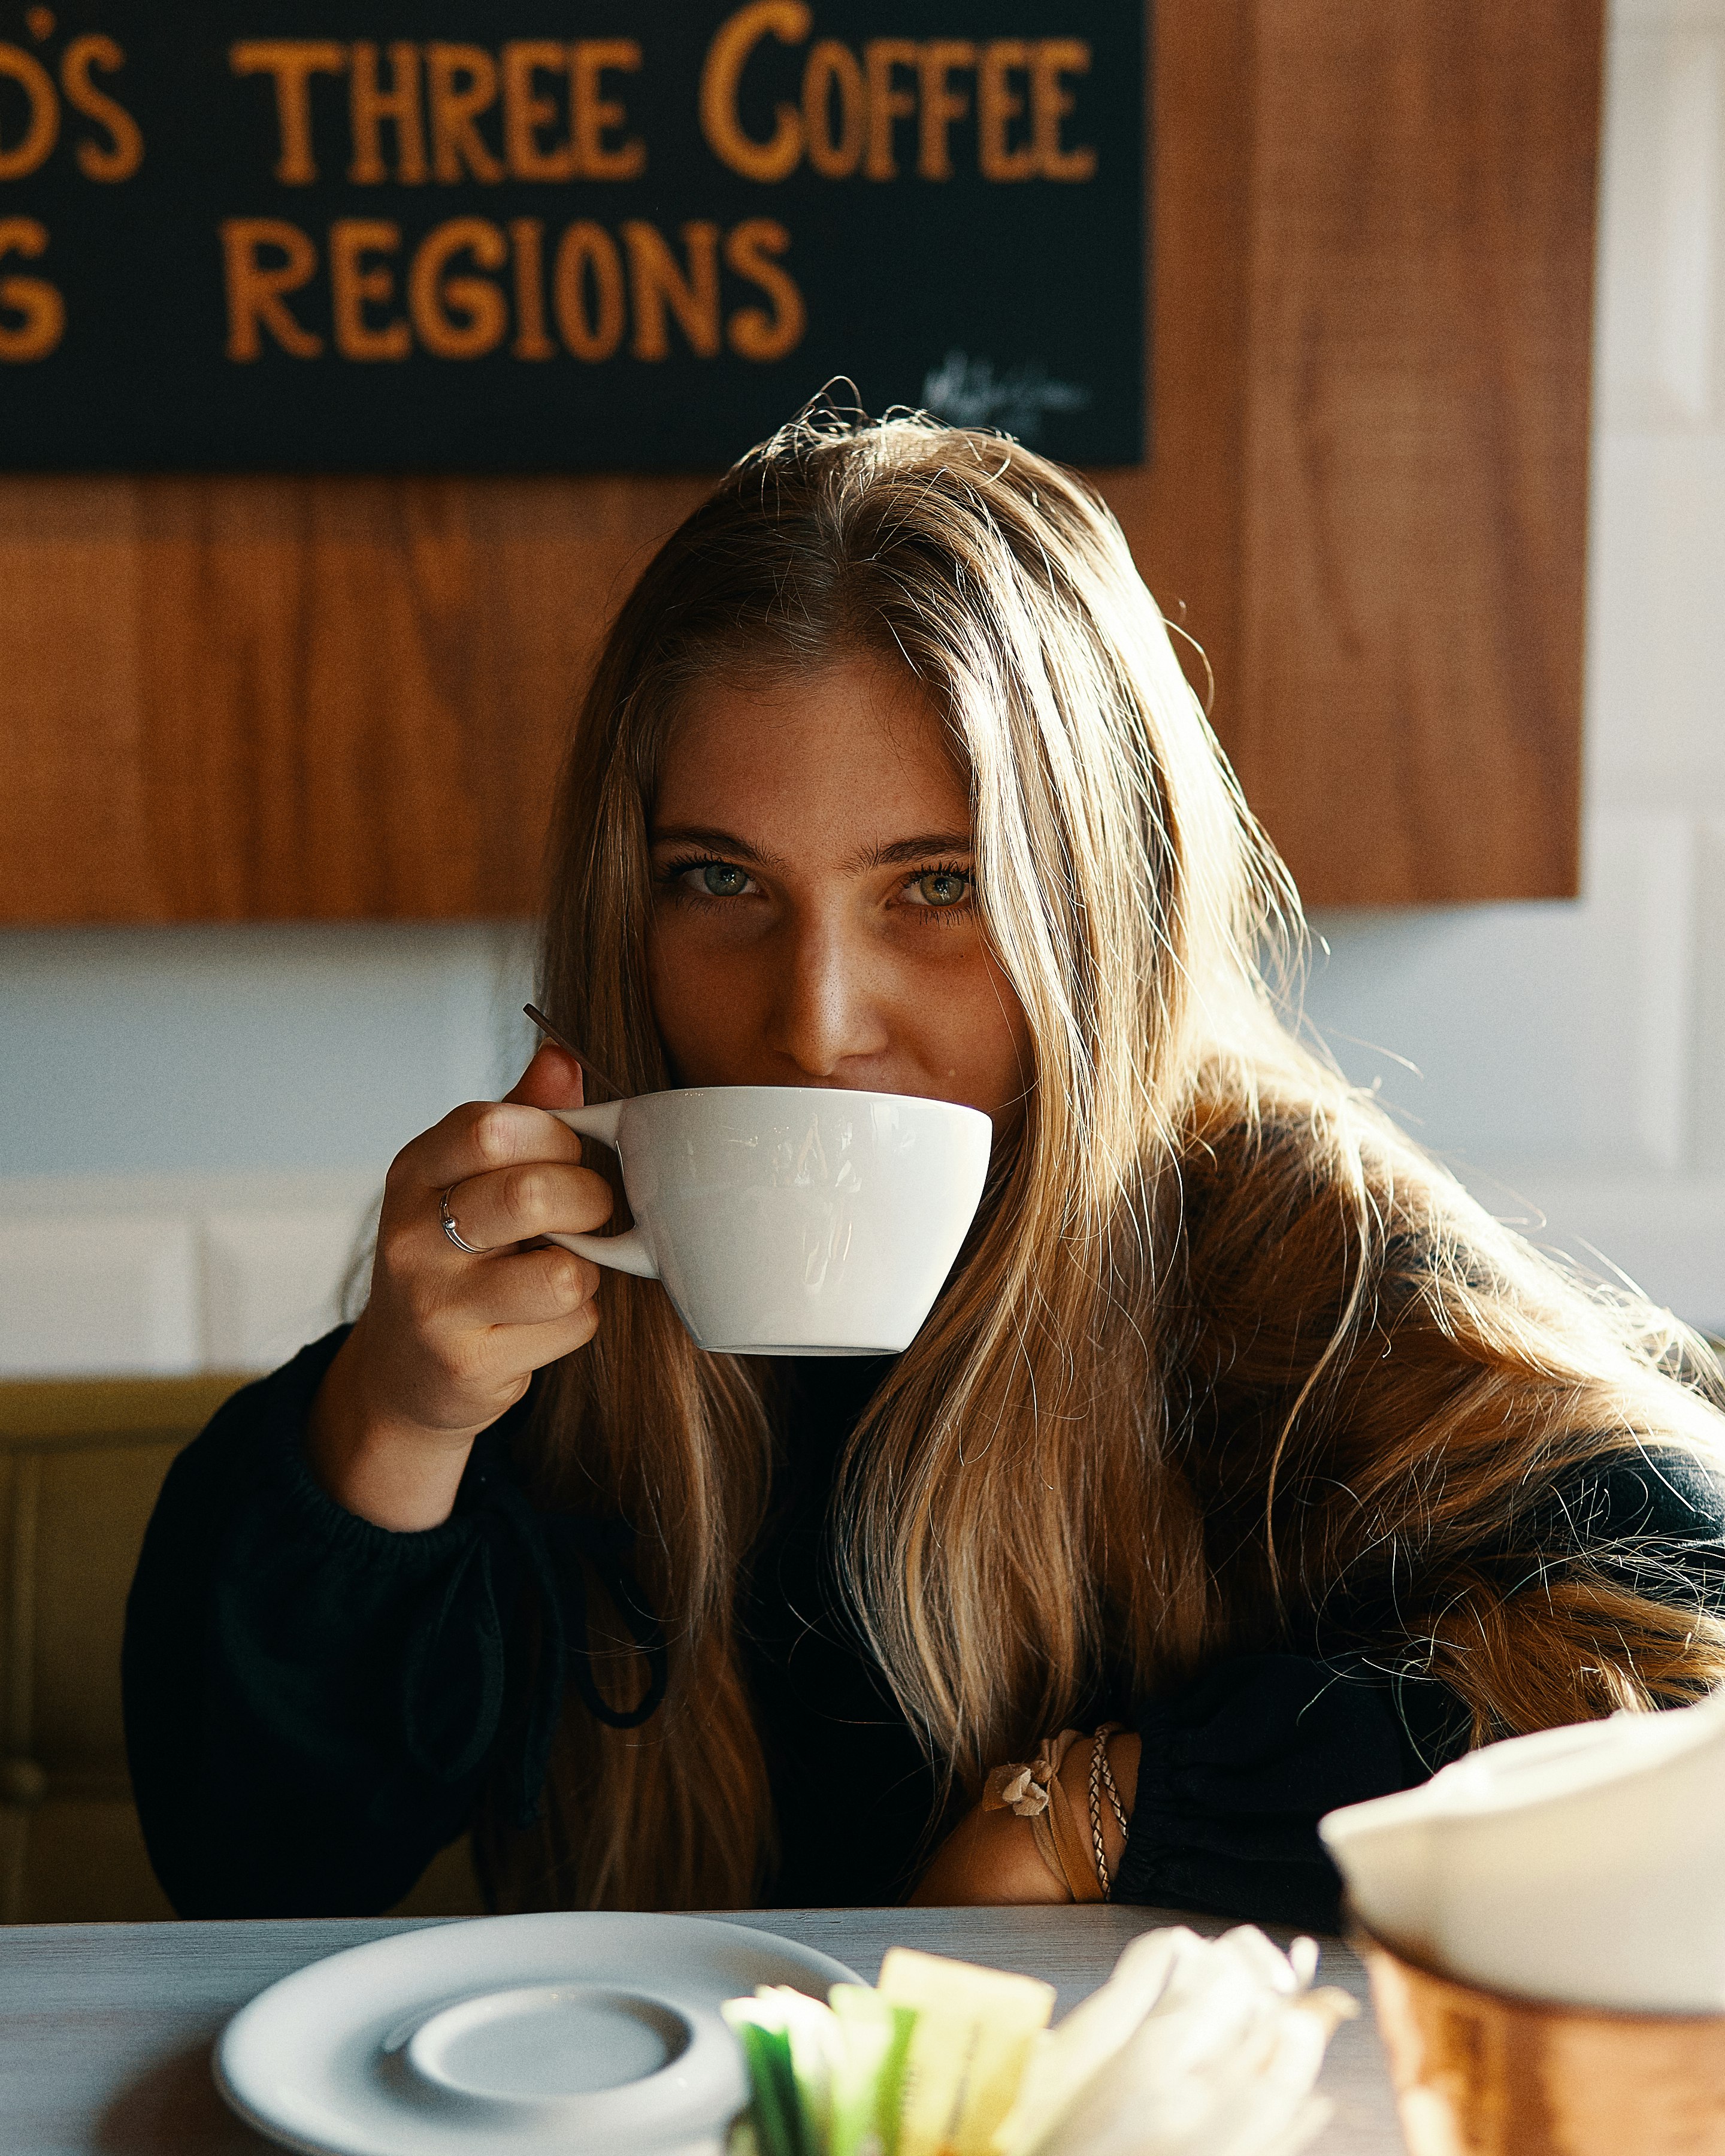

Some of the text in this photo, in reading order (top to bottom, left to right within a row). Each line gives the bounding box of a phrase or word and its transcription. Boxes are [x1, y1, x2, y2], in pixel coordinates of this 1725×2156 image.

[231, 39, 643, 183] THREE
[701, 0, 1094, 181] COFFEE
[222, 217, 803, 360] REGIONS
